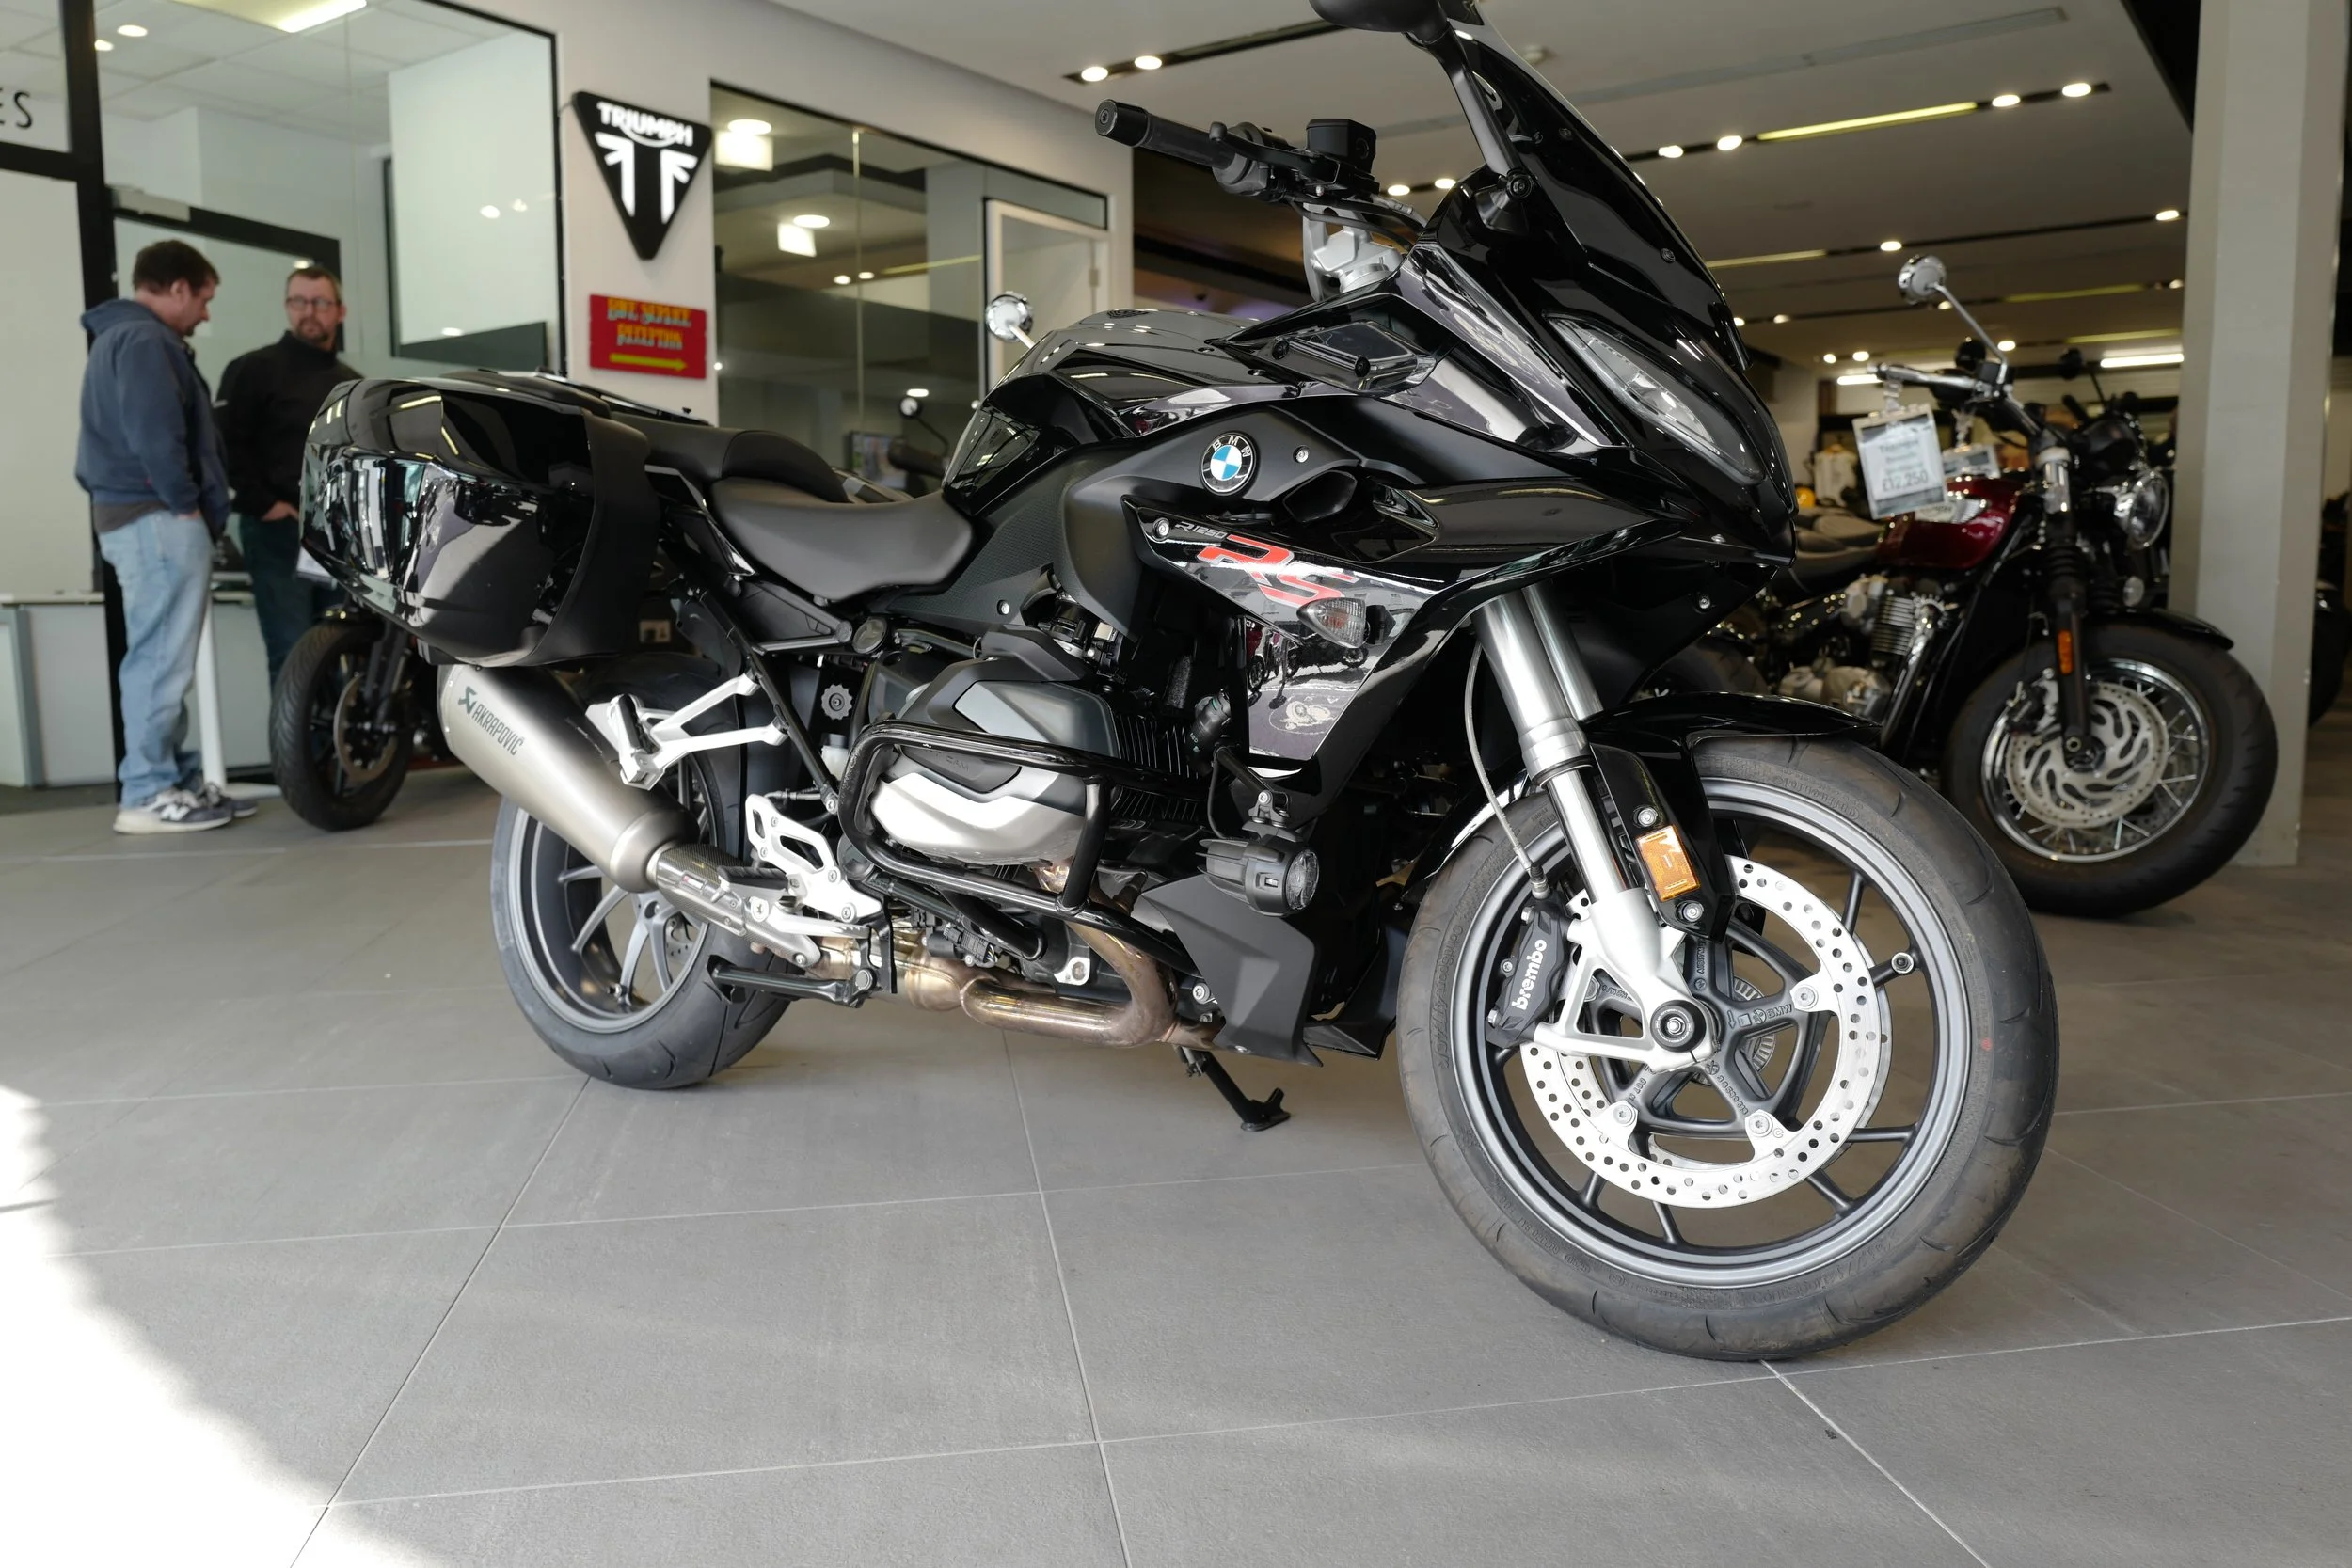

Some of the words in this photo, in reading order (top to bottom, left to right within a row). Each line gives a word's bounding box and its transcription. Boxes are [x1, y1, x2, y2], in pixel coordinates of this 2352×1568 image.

[0, 89, 33, 130] S
[596, 101, 694, 147] TRIUMPH
[1212, 436, 1251, 458] BMW
[1175, 521, 1228, 539] R1250
[1196, 534, 1360, 608] RS
[471, 703, 525, 756] AKRAPOVIČ
[1511, 939, 1548, 1011] brembo
[1766, 1003, 1793, 1020] BMW
